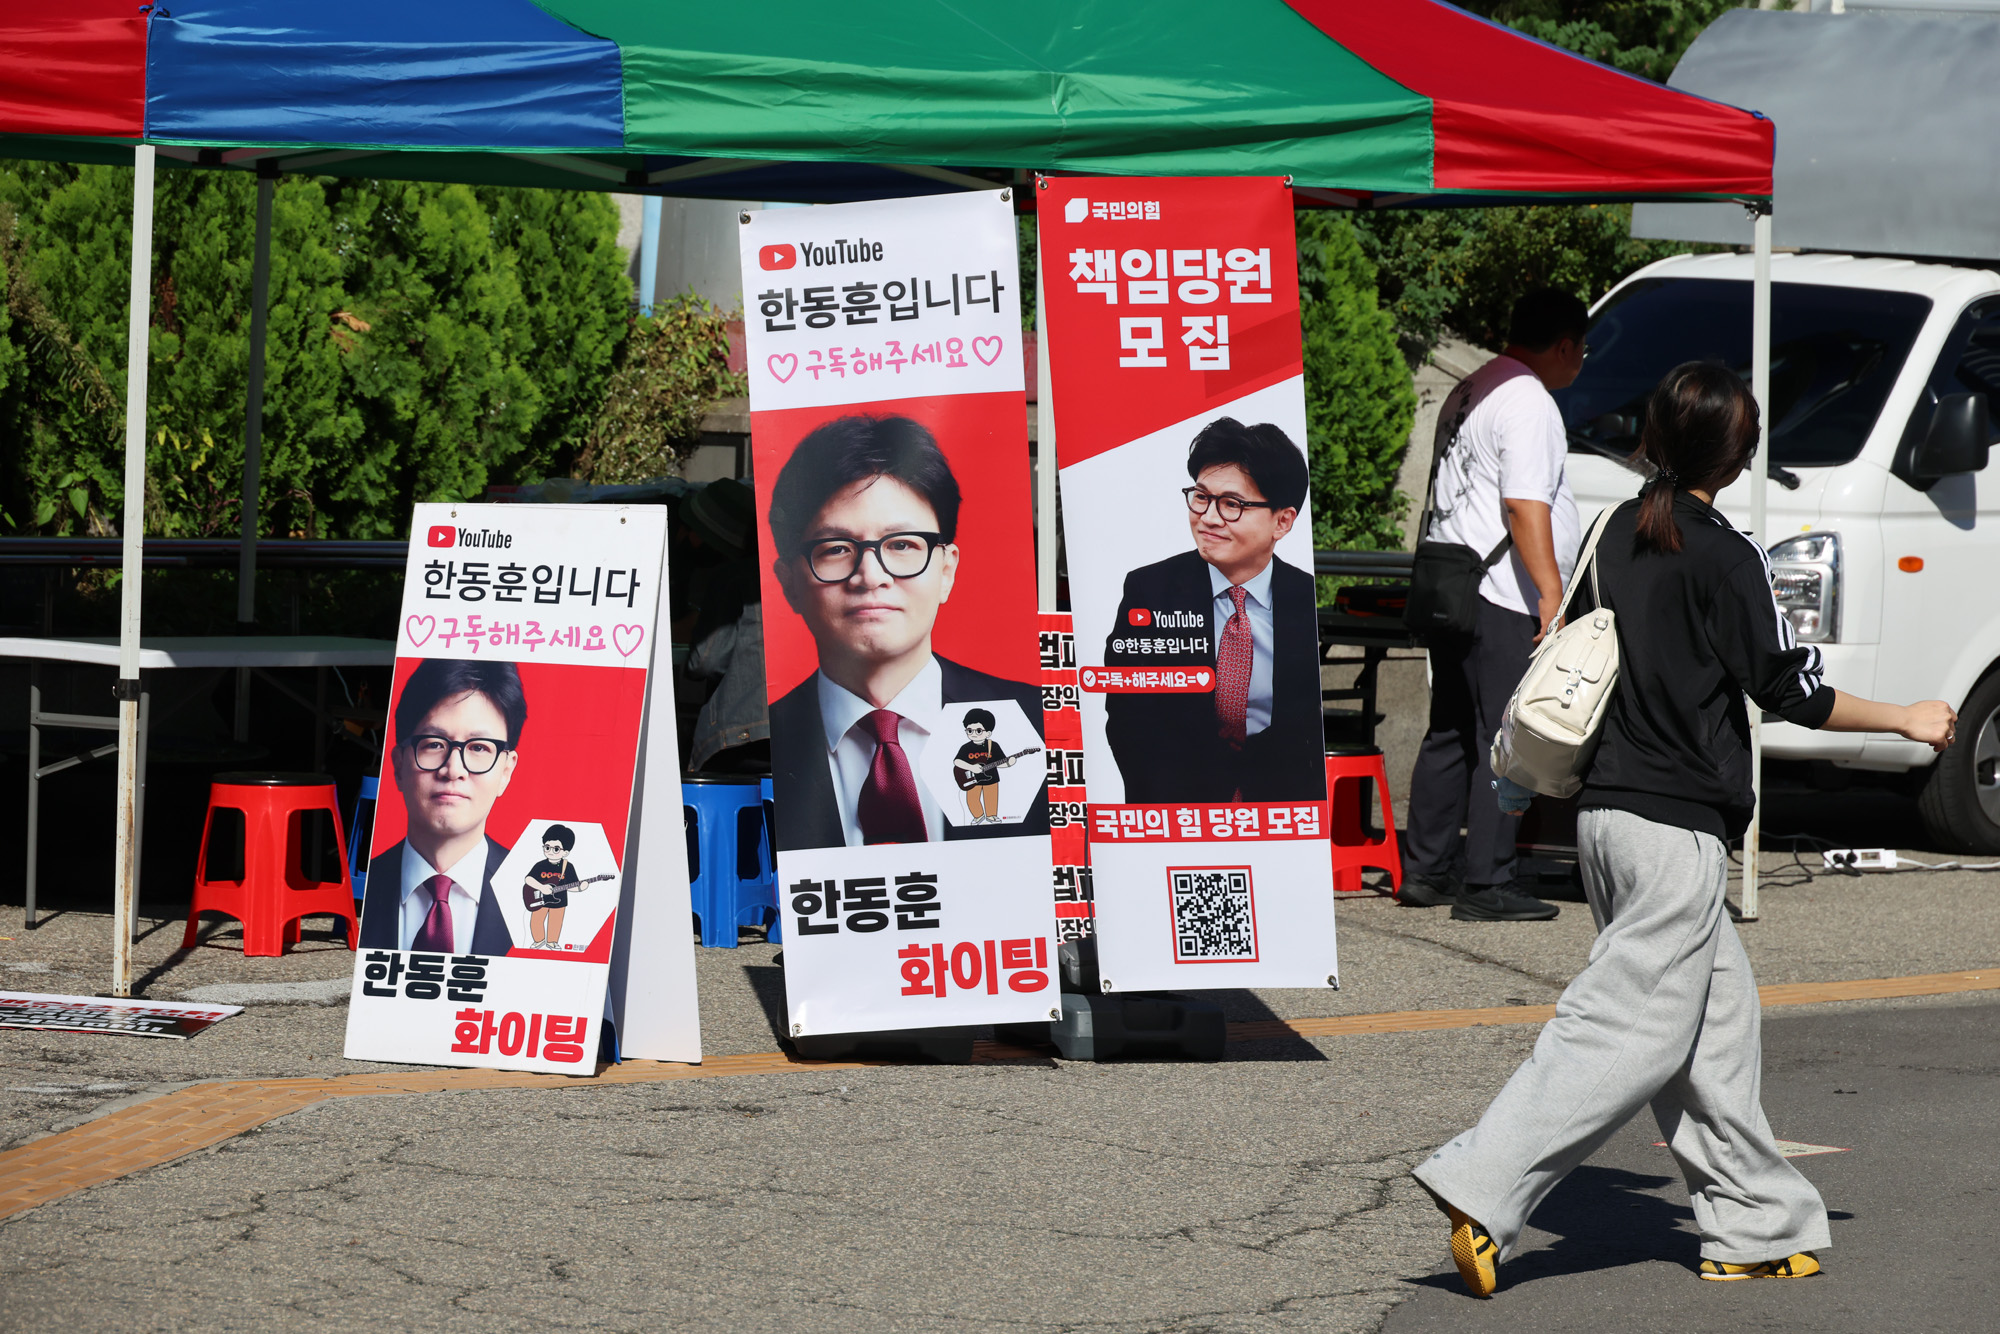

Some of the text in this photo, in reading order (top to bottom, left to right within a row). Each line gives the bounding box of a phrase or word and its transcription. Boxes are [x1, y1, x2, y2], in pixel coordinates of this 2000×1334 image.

[1092, 200, 1160, 220] 국민의힘
[800, 238, 884, 267] YouTube
[1069, 248, 1272, 304] 책임당원
[758, 270, 1004, 332] 한동훈입니다
[806, 338, 968, 379] 구독해주세요
[458, 527, 512, 550] YouTube
[424, 559, 640, 608] 한동훈입니다
[437, 615, 606, 653] 구독해주세요
[1153, 610, 1204, 628] YouTube
[1112, 637, 1209, 654] @한동훈입니다
[1208, 807, 1260, 837] 당원
[1267, 806, 1320, 836] 모집
[790, 871, 941, 936] 한동훈
[362, 951, 489, 1002] 한동훈
[898, 937, 1049, 998] 화이팅
[451, 1008, 587, 1063] 화이팅
